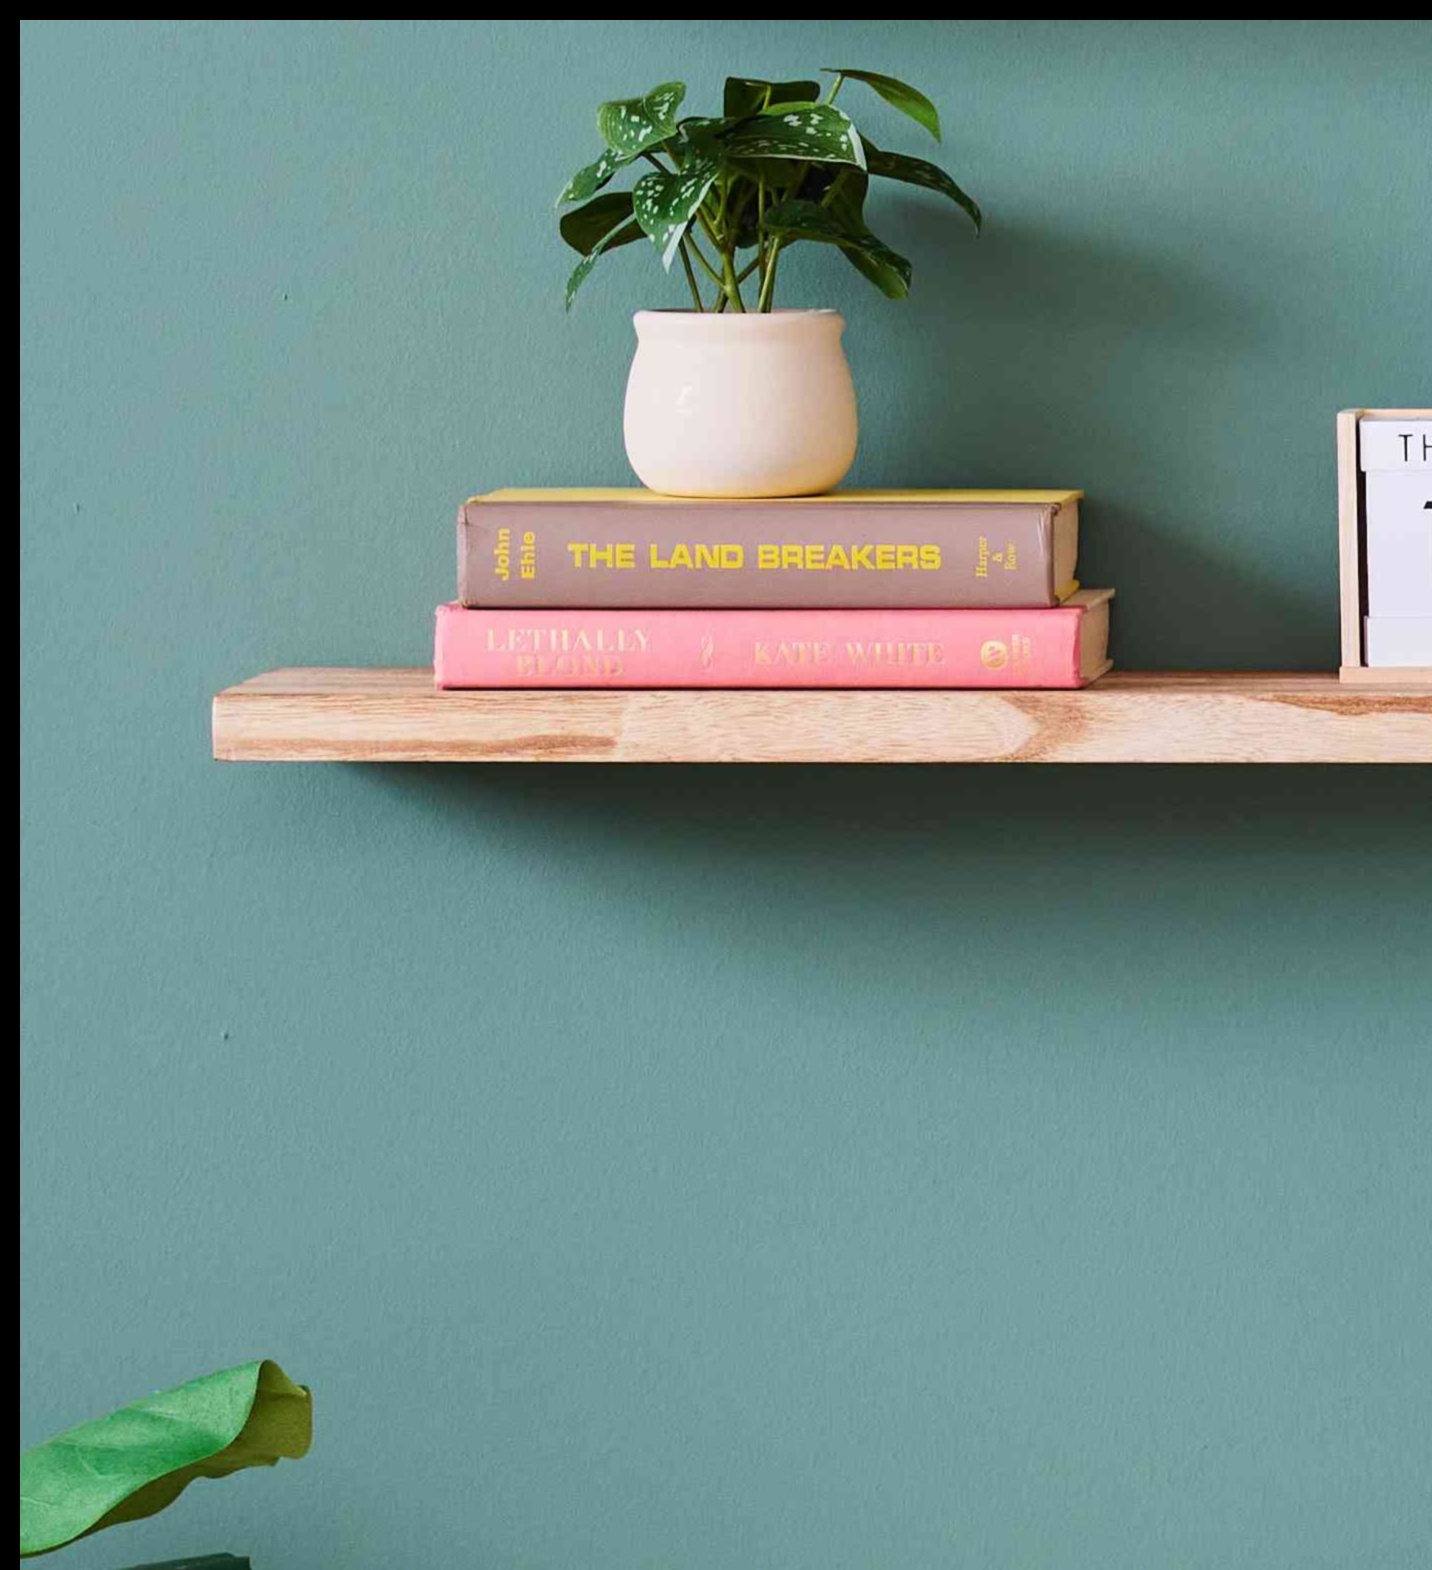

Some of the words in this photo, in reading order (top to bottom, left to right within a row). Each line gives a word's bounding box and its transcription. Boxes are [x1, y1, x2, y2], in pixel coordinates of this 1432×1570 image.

[494, 528, 510, 581] John
[520, 531, 536, 579] Ehle
[567, 543, 635, 569] THE
[650, 543, 744, 569] LAND
[757, 543, 942, 570] BREAKERS
[486, 628, 652, 651] LETHALLY
[515, 655, 625, 678] BLOND
[754, 642, 830, 665] KATE
[846, 642, 949, 666] WHITE
